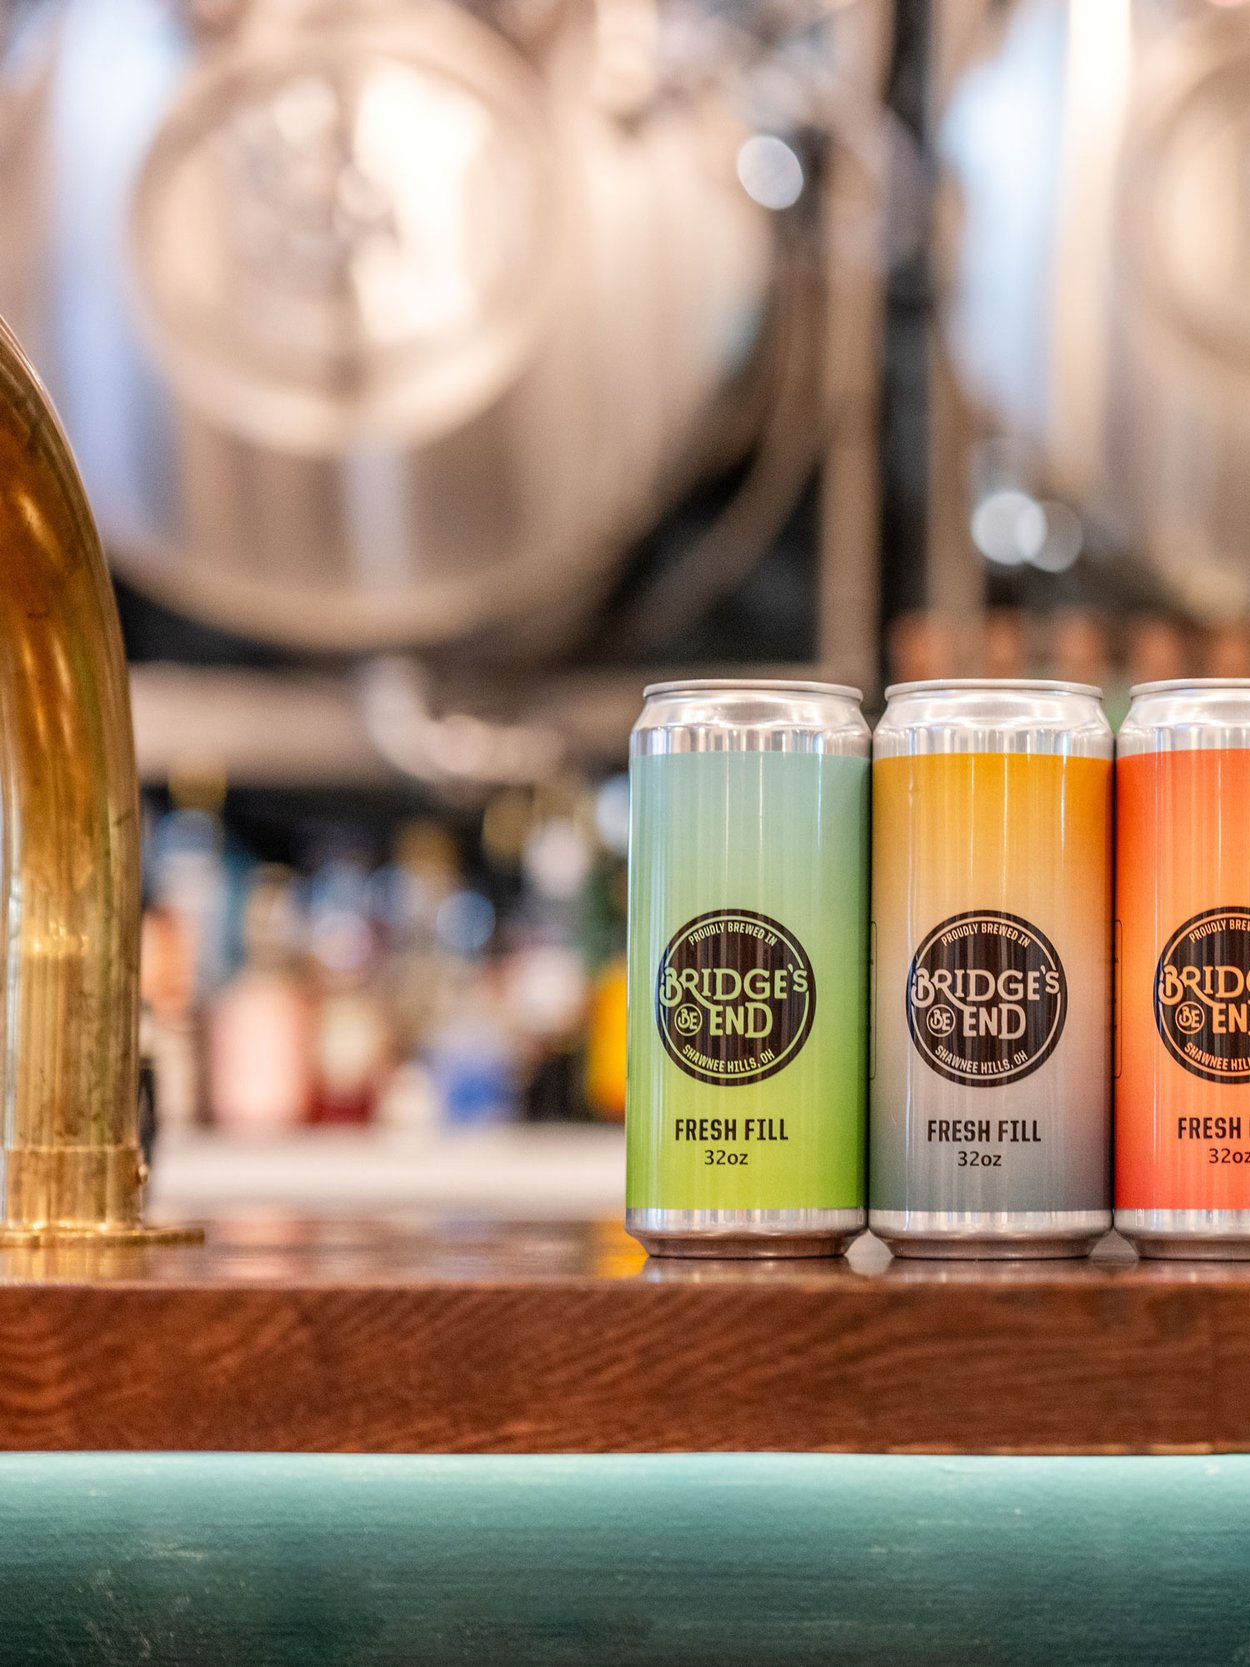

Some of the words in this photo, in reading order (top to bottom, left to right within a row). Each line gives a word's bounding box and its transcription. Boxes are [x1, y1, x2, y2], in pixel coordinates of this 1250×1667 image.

[688, 922, 724, 946] PROUDLY
[728, 922, 765, 938] BREWED
[765, 933, 777, 946] IN
[941, 924, 978, 946] PROUDLY
[982, 923, 1018, 940] BREWED
[1018, 934, 1031, 947] IN
[1189, 920, 1226, 943] PROUDLY
[659, 963, 808, 1007] BRIDGE'S
[911, 965, 1059, 1008] BRIDGE'S
[678, 1008, 697, 1029] BE
[710, 1002, 772, 1038] END
[930, 1010, 951, 1031] BE
[962, 1004, 1026, 1039] END
[1179, 1006, 1199, 1028] BE
[682, 1044, 724, 1072] SHAWNEE
[727, 1055, 761, 1073] HILLS,
[761, 1049, 775, 1064] OH
[935, 1045, 978, 1073] SHAWNEE
[981, 1057, 1014, 1074] HILLS,
[1014, 1050, 1028, 1065] OH
[1184, 1042, 1228, 1070] SHAWNEE
[675, 1119, 737, 1140] FRESH
[745, 1119, 788, 1140] FILL
[927, 1120, 990, 1142] FRESH
[998, 1120, 1041, 1142] FILL
[1178, 1117, 1241, 1139] FRESH
[704, 1150, 748, 1165] 32oz
[958, 1152, 1001, 1166] 32oz
